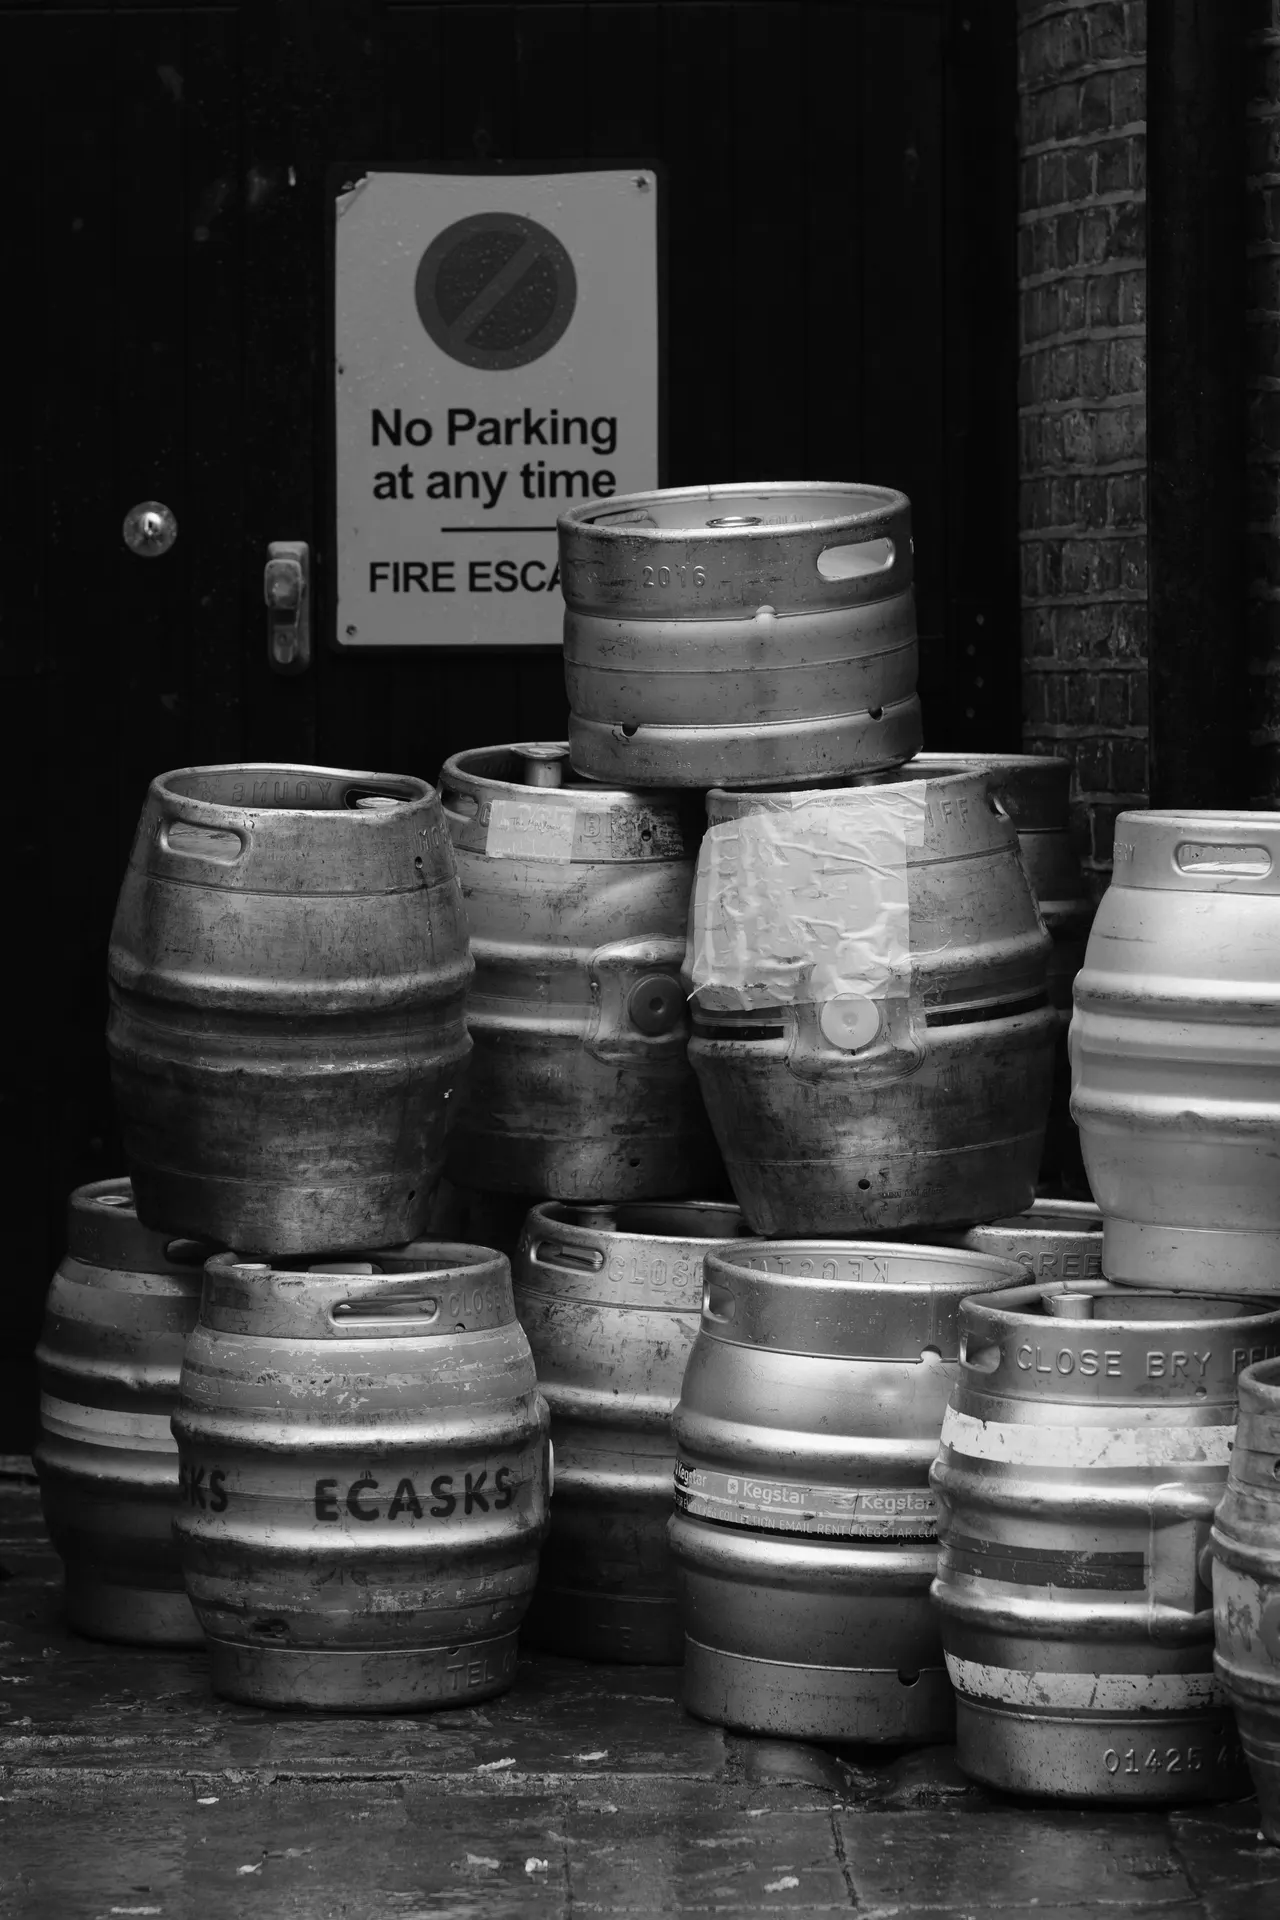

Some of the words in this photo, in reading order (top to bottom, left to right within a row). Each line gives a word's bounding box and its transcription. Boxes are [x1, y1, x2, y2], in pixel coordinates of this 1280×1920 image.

[371, 408, 433, 447] No
[447, 407, 617, 455] Parking
[373, 463, 414, 500] at
[426, 469, 507, 510] any
[520, 460, 616, 499] time
[369, 561, 456, 593] FIRE
[642, 565, 706, 589] 2016
[1016, 1344, 1122, 1377] CLOSE
[1147, 1350, 1212, 1378] BRY
[314, 1467, 516, 1521] ECASKS
[743, 1481, 809, 1505] Kegstar
[861, 1494, 931, 1514] Kegstar
[446, 1659, 495, 1691] TEL
[1103, 1747, 1202, 1775] 01425
